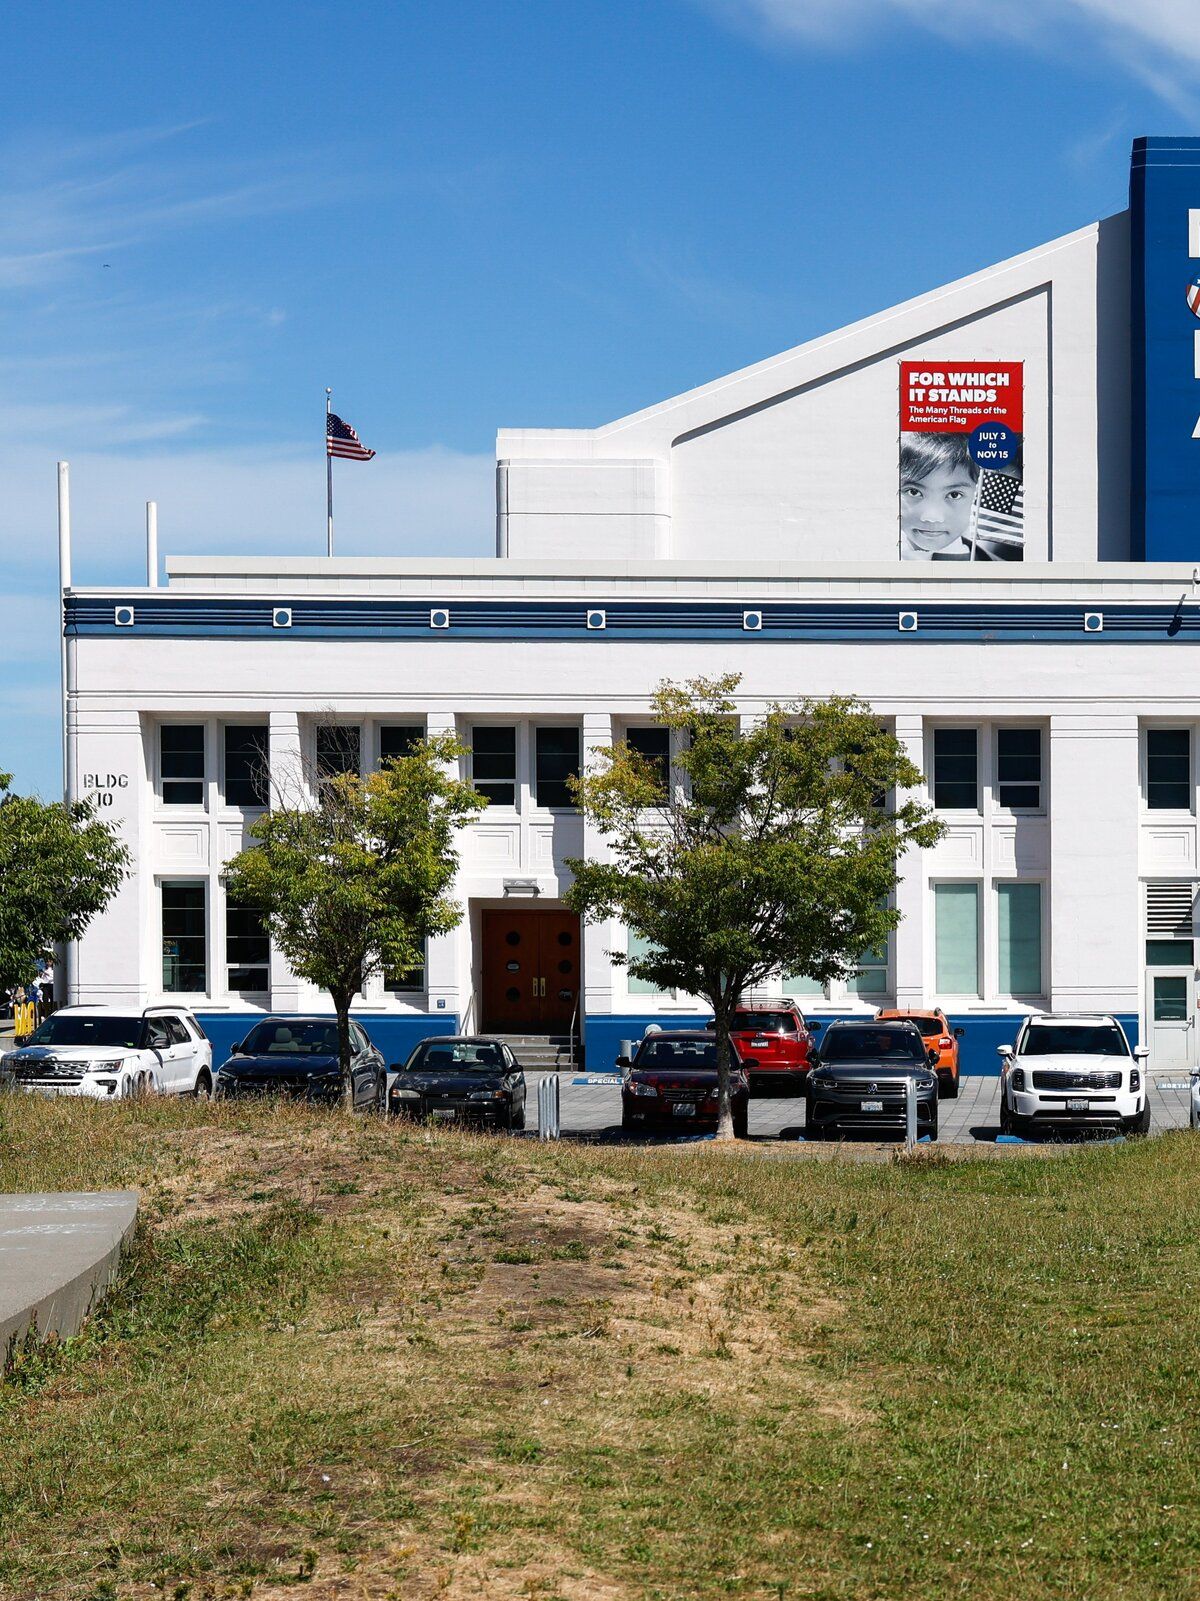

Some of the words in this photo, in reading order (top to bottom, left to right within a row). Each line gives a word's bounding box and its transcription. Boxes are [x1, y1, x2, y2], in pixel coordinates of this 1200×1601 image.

[909, 372, 946, 386] FOR
[948, 372, 1010, 386] WHICH
[909, 389, 926, 402] IT
[928, 389, 997, 402] STANDS
[909, 406, 924, 414] The
[926, 406, 948, 415] Many
[949, 406, 982, 414] Threads
[983, 406, 993, 414] of
[994, 406, 1007, 414] the
[909, 415, 948, 423] American
[949, 415, 967, 424] Flag
[979, 432, 999, 441] JULY
[1000, 432, 1006, 440] 3
[989, 441, 997, 449] to
[977, 450, 998, 459] NOV
[999, 450, 1009, 459] 15
[83, 774, 129, 788] BLDG
[97, 792, 113, 807] 10
